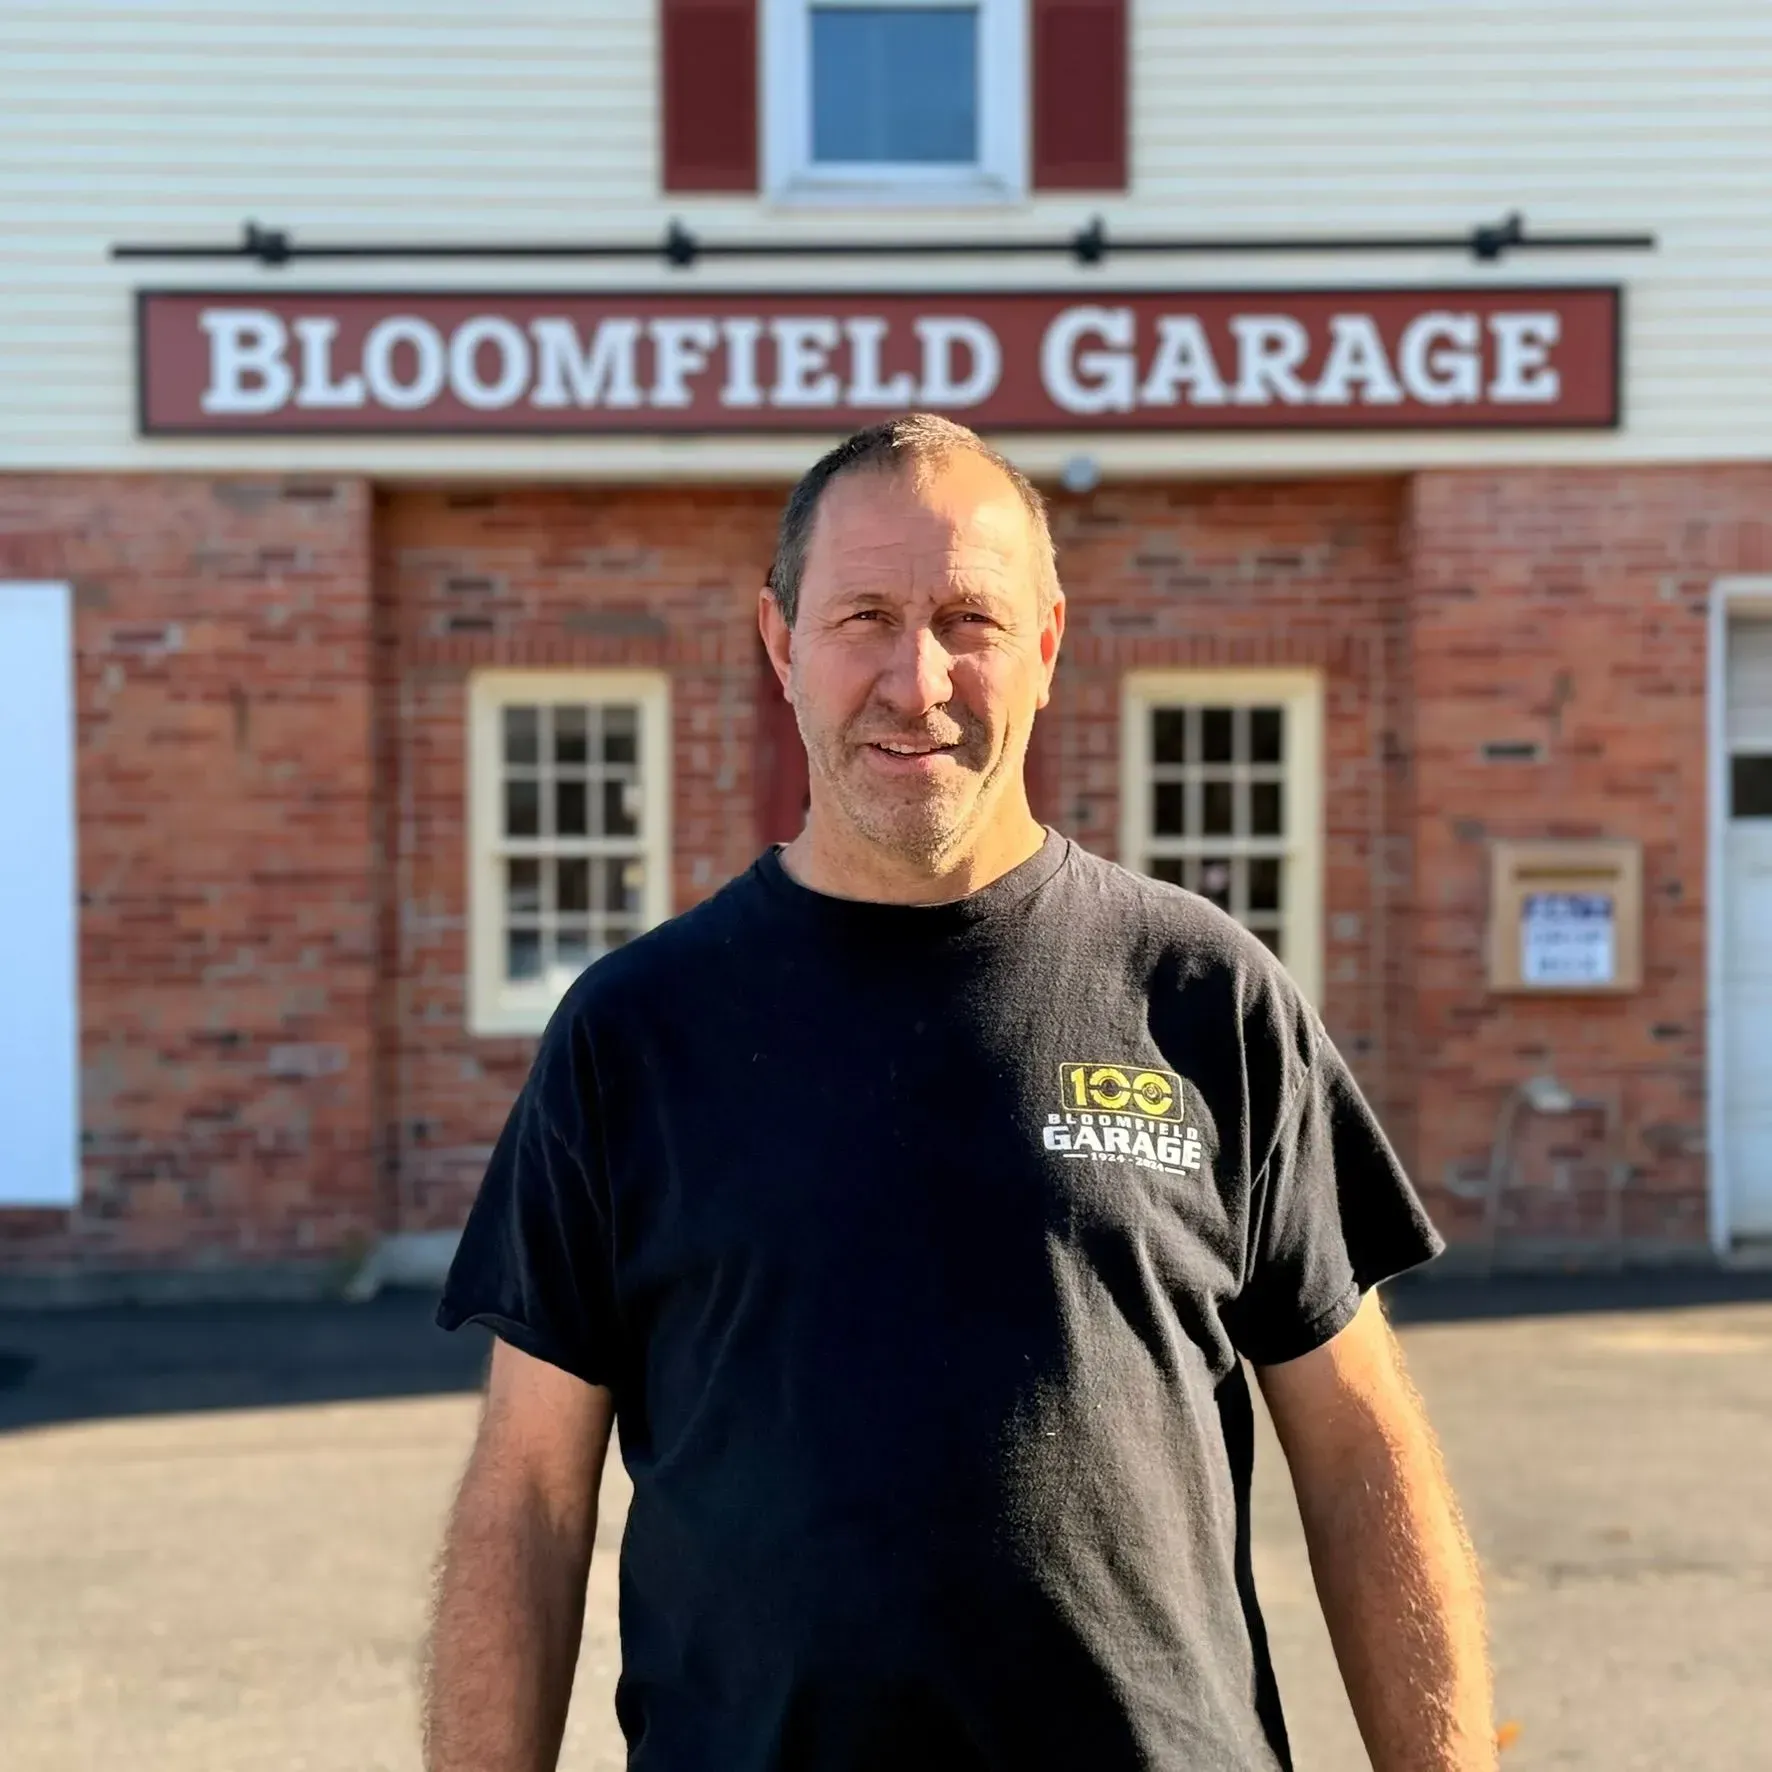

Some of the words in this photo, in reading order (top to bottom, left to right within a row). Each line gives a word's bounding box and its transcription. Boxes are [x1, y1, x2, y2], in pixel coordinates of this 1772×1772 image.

[201, 309, 1000, 413] BLOOMFIELD
[1041, 306, 1561, 413] GARAGE
[1071, 1067, 1172, 1115] 100
[1043, 1125, 1201, 1170] GARAGE
[1048, 1113, 1198, 1141] BLOOMFIELD
